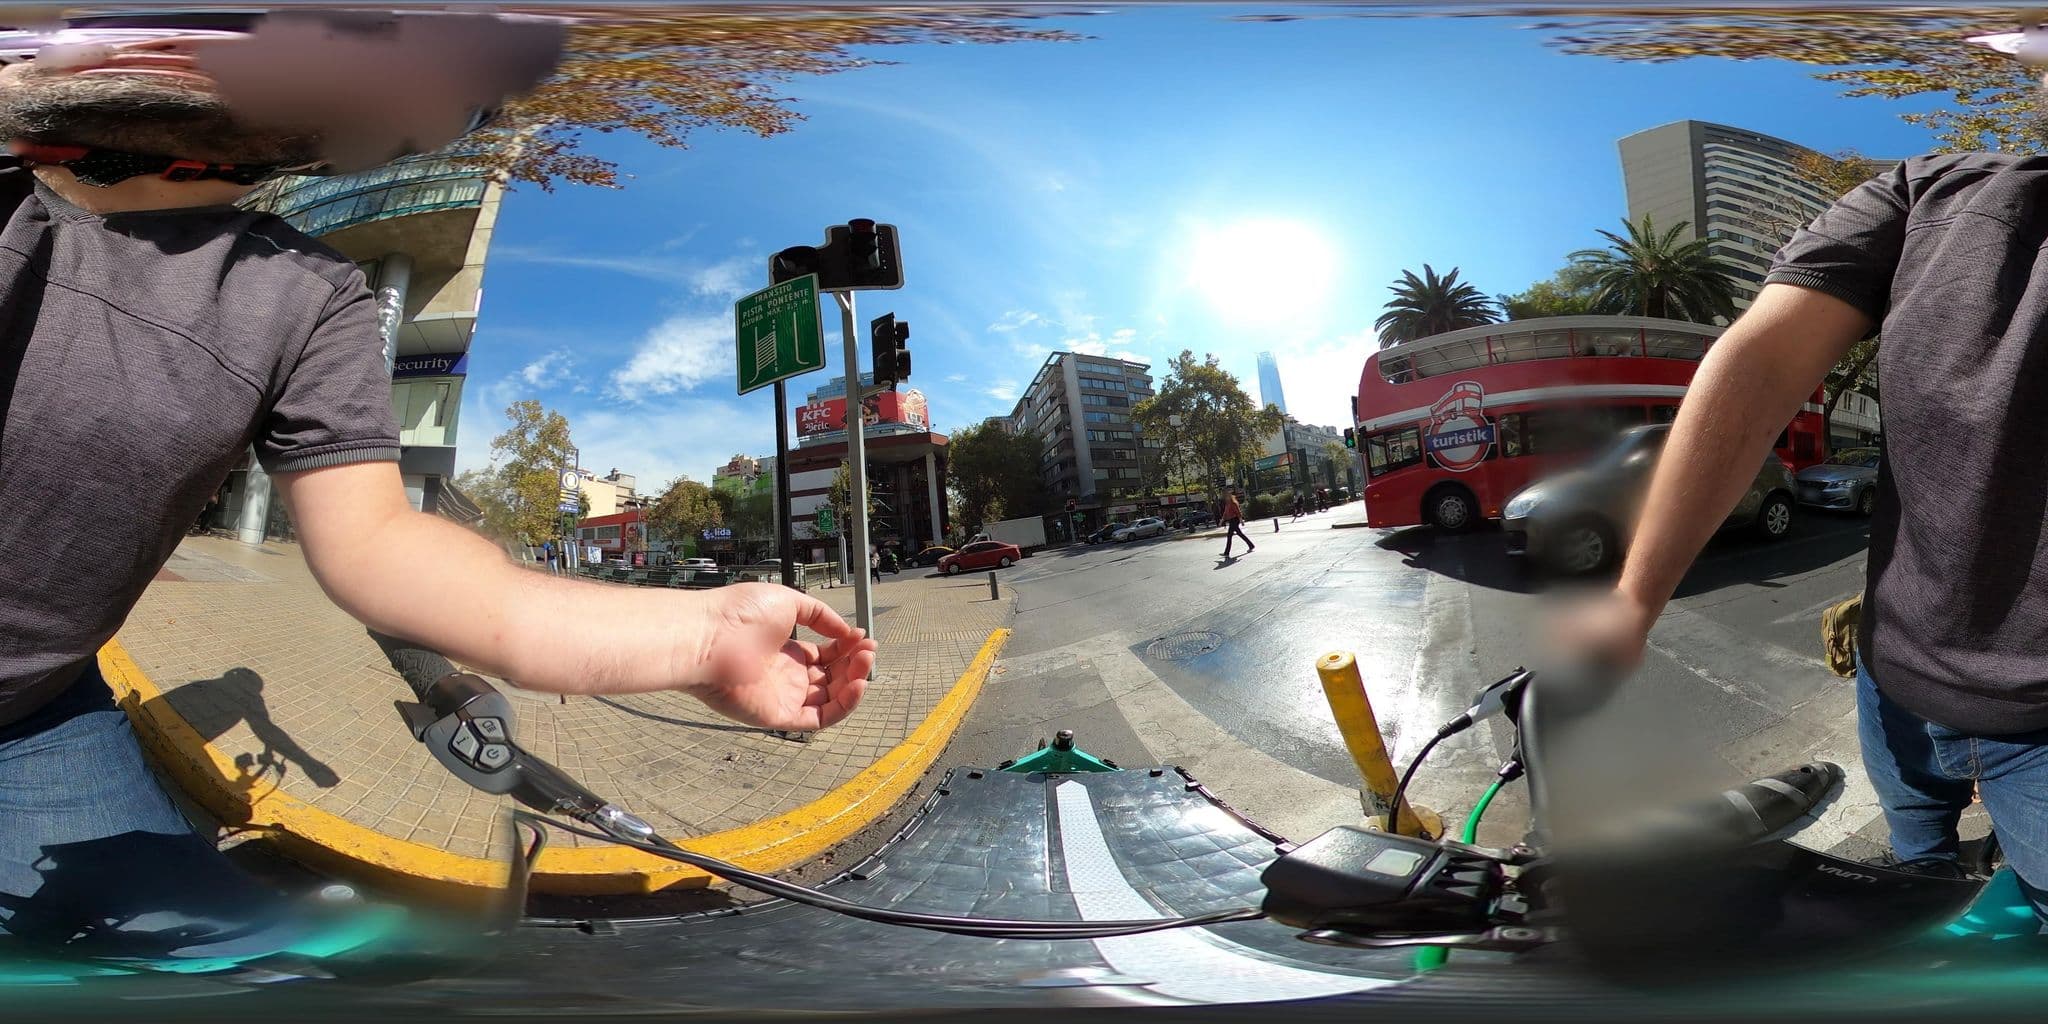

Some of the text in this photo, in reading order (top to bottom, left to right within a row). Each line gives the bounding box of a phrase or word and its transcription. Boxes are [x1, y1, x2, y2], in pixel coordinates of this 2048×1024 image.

[754, 284, 792, 303] TRANSITO
[743, 288, 809, 320] PISTA PONIENTE
[801, 407, 831, 422] KFC
[1432, 429, 1488, 448] turistik
